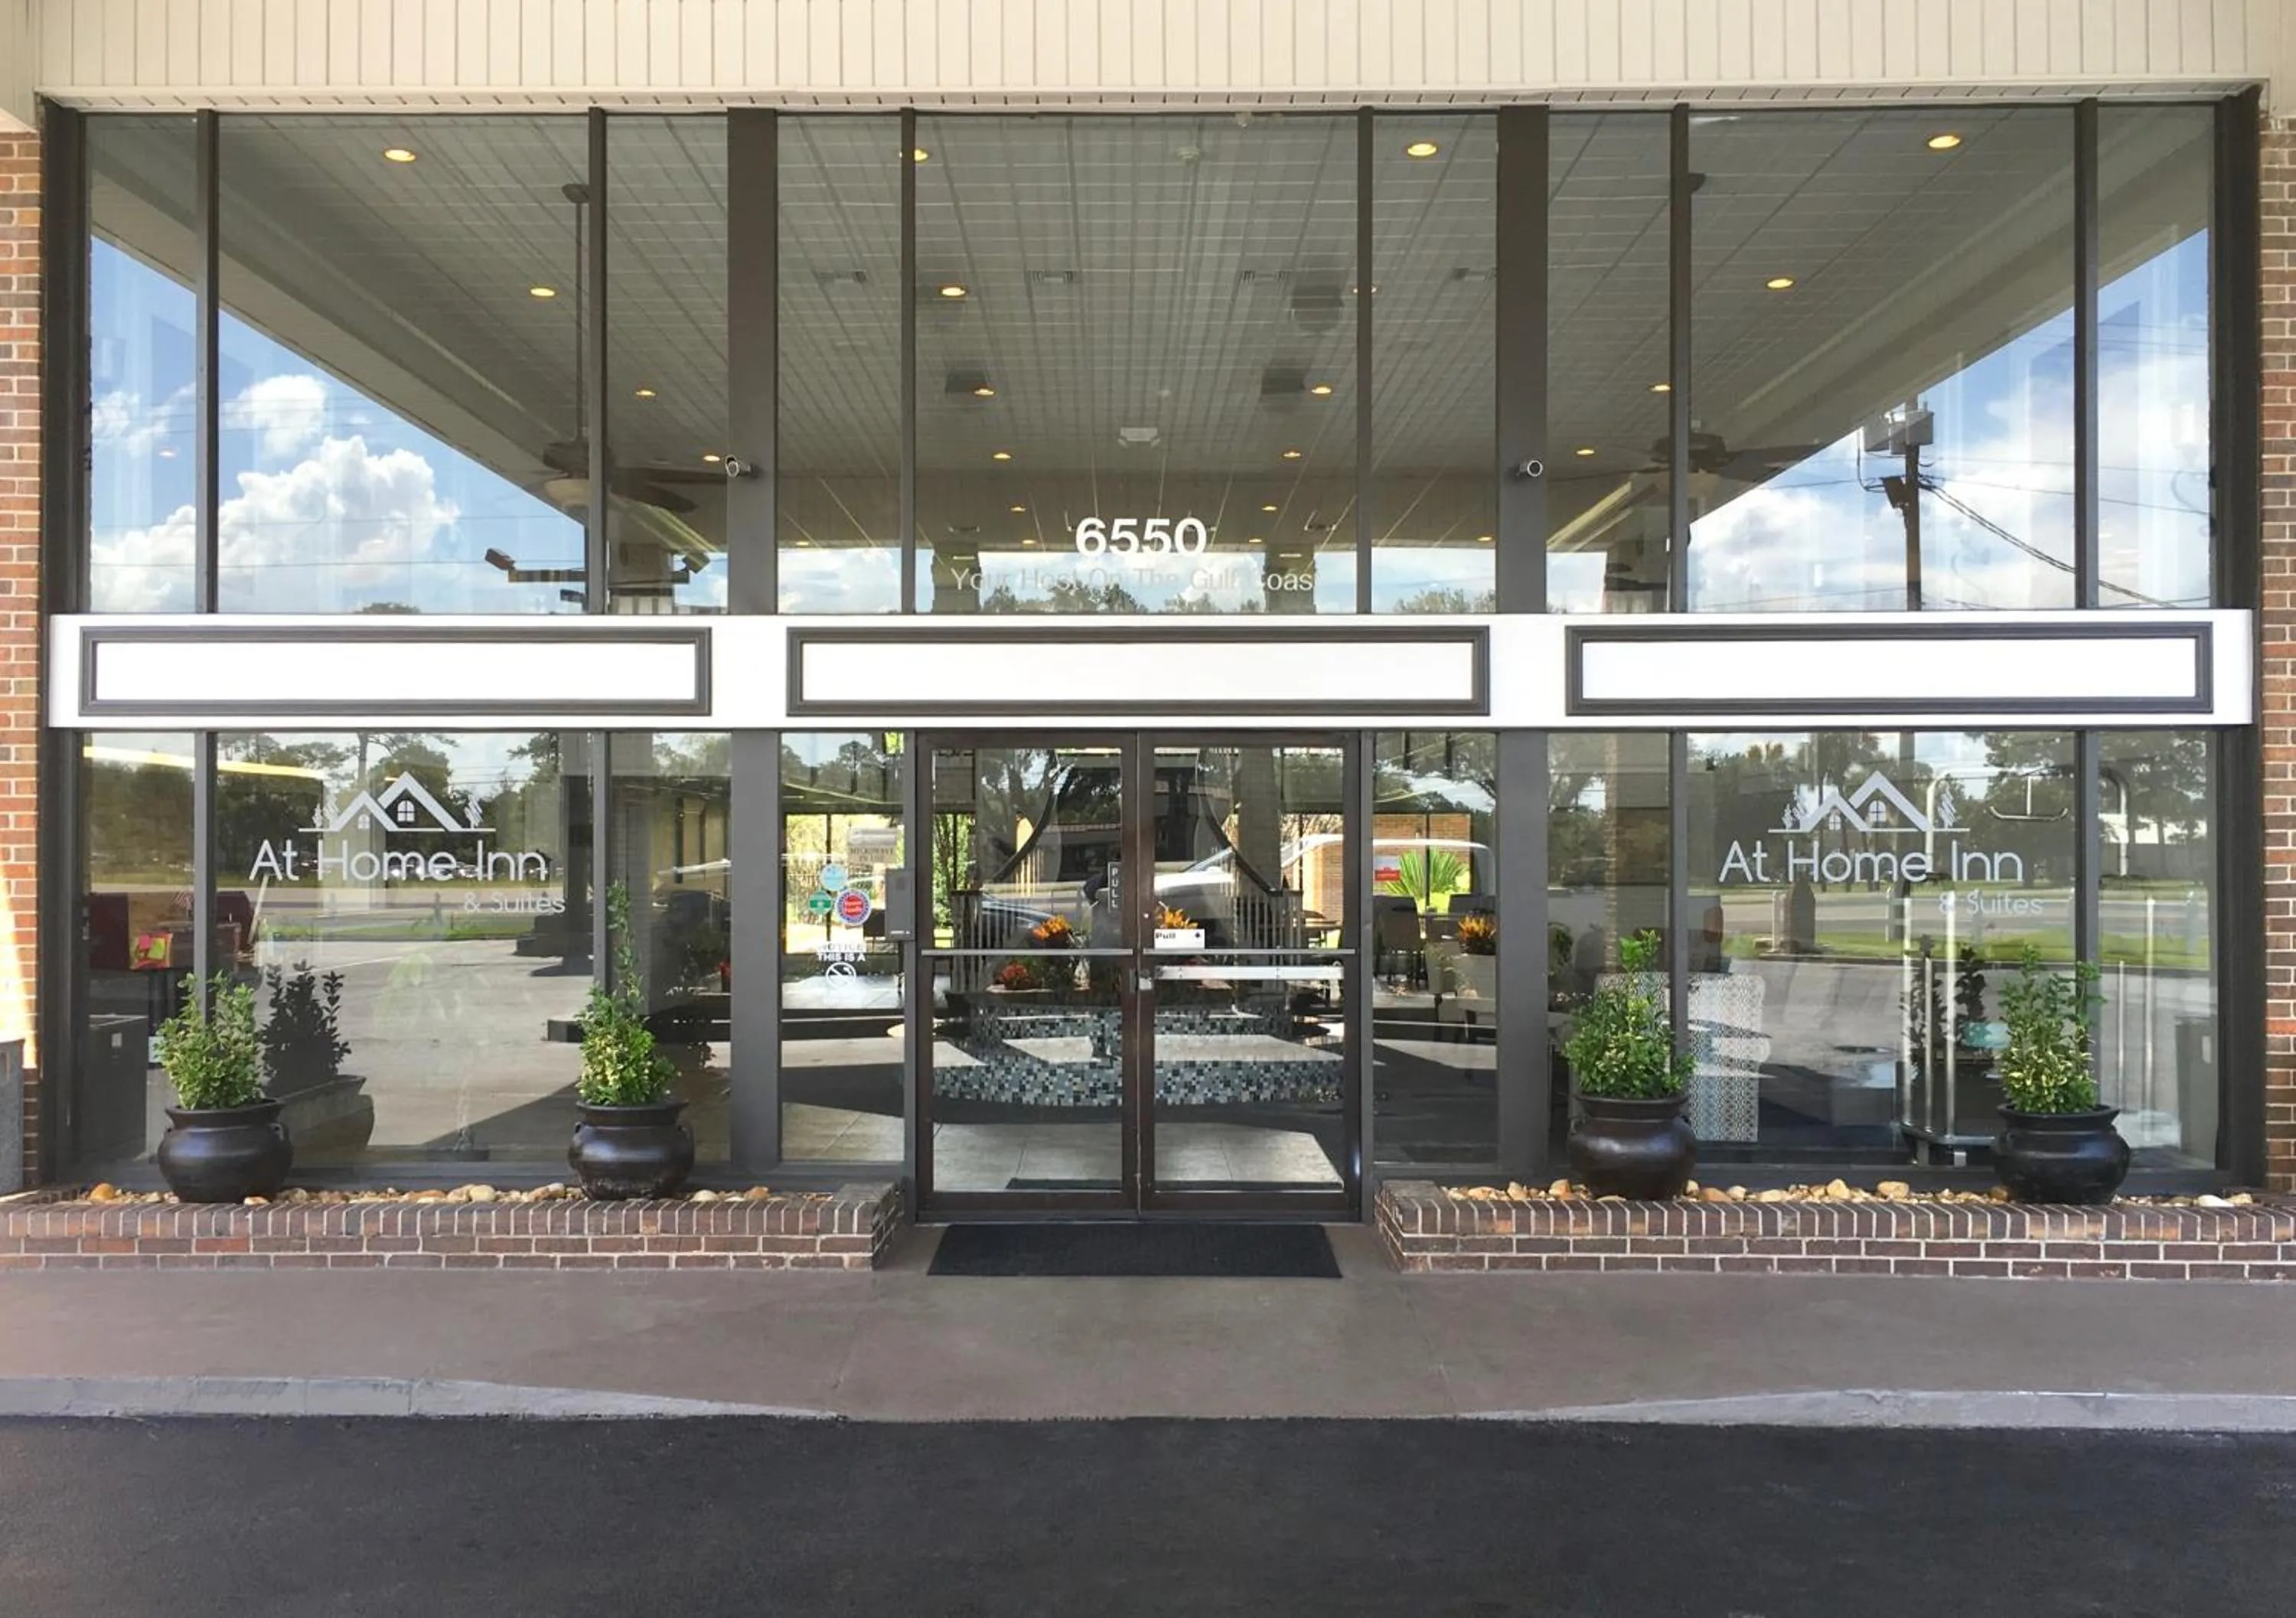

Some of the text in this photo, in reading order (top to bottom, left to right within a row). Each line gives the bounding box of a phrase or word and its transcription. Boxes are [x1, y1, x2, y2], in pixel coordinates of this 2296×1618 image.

[1075, 517, 1208, 558] 6550
[951, 568, 1010, 591] Your
[1022, 568, 1080, 591] Host
[1089, 568, 1123, 590] On
[1134, 568, 1179, 589] The
[1190, 568, 1239, 590] Gulf
[249, 840, 546, 882] At Home Inn
[1719, 839, 2024, 882] At Home Inn
[464, 891, 566, 913] & Suites
[1966, 891, 2043, 915] Suites
[818, 951, 841, 962] THIS
[856, 951, 866, 962] A
